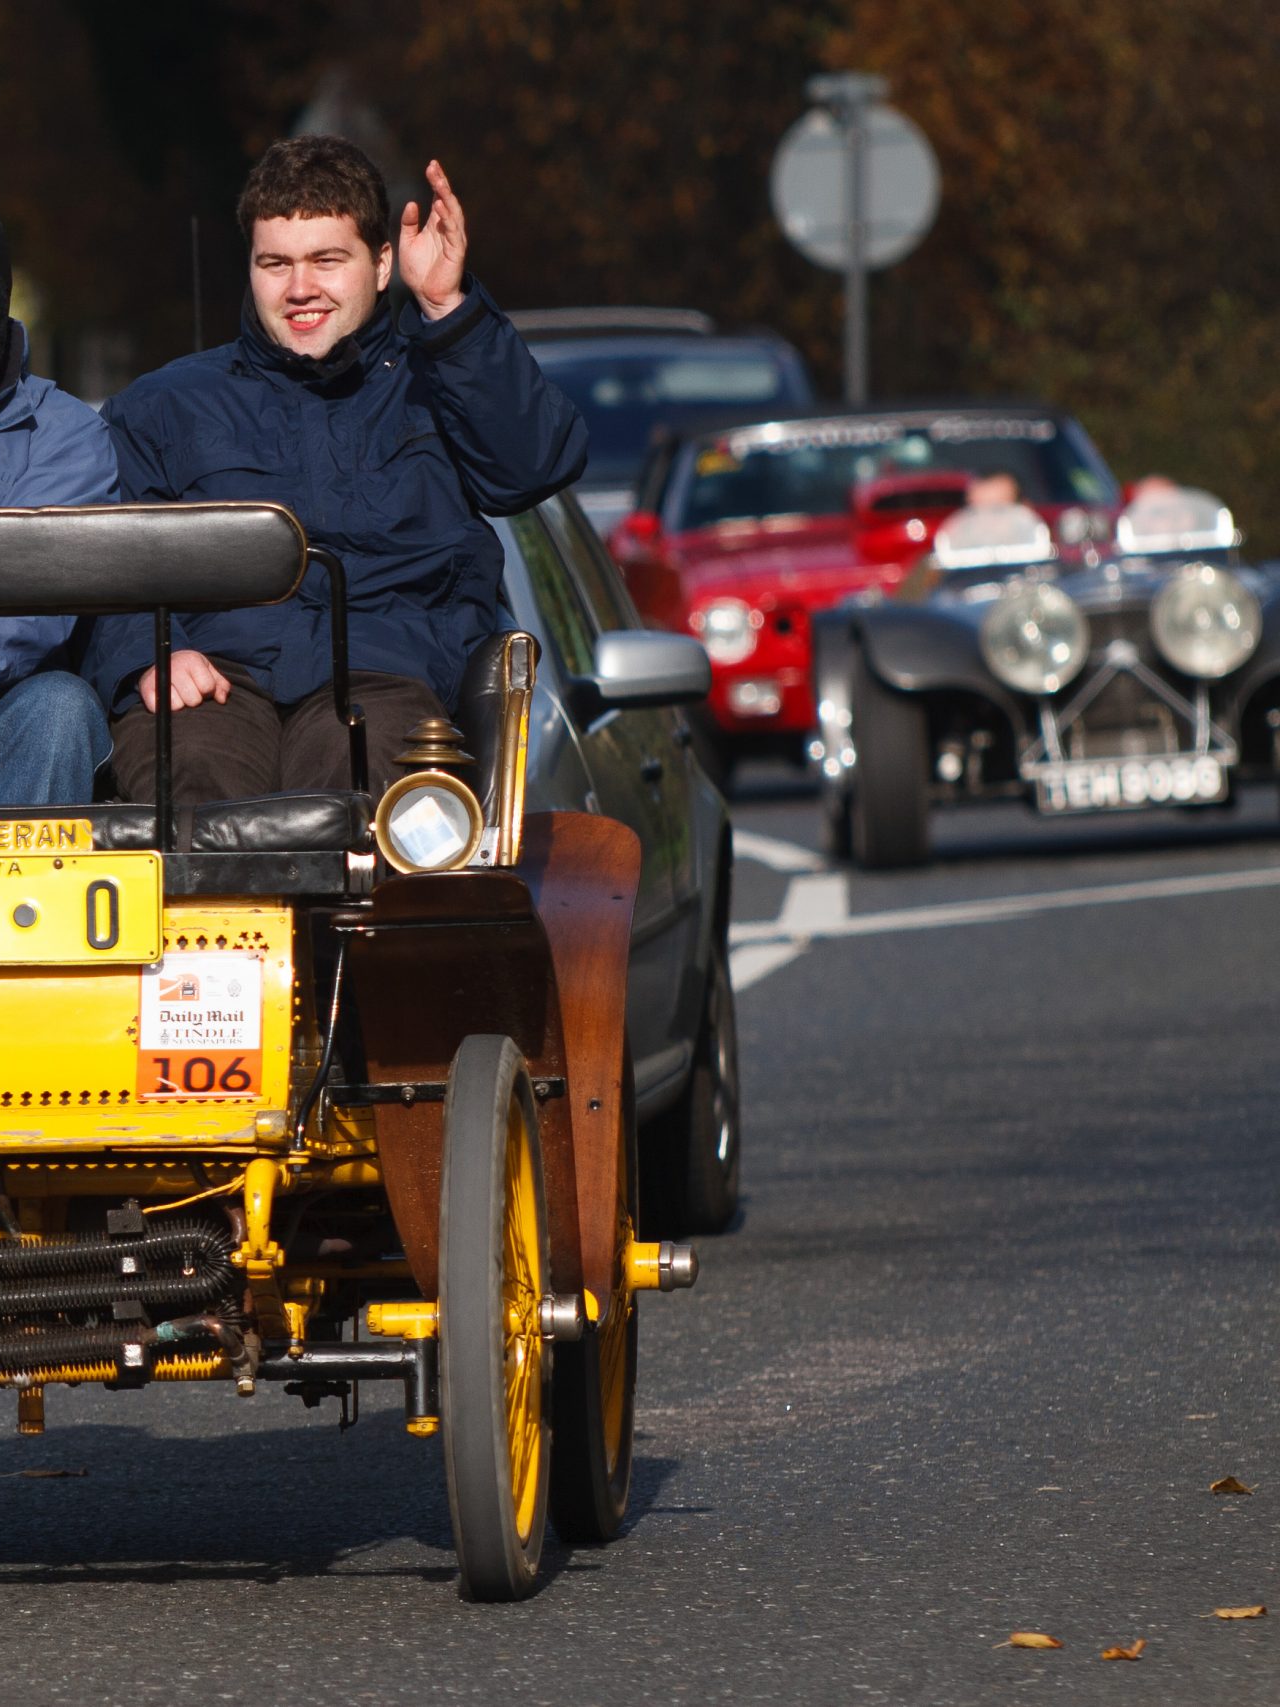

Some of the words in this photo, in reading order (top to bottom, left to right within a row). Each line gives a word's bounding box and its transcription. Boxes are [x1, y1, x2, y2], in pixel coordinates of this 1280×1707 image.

[159, 1010, 203, 1026] Daily
[206, 1010, 245, 1022] Mail
[172, 1029, 243, 1038] TINDLE
[152, 1057, 252, 1094] 106
